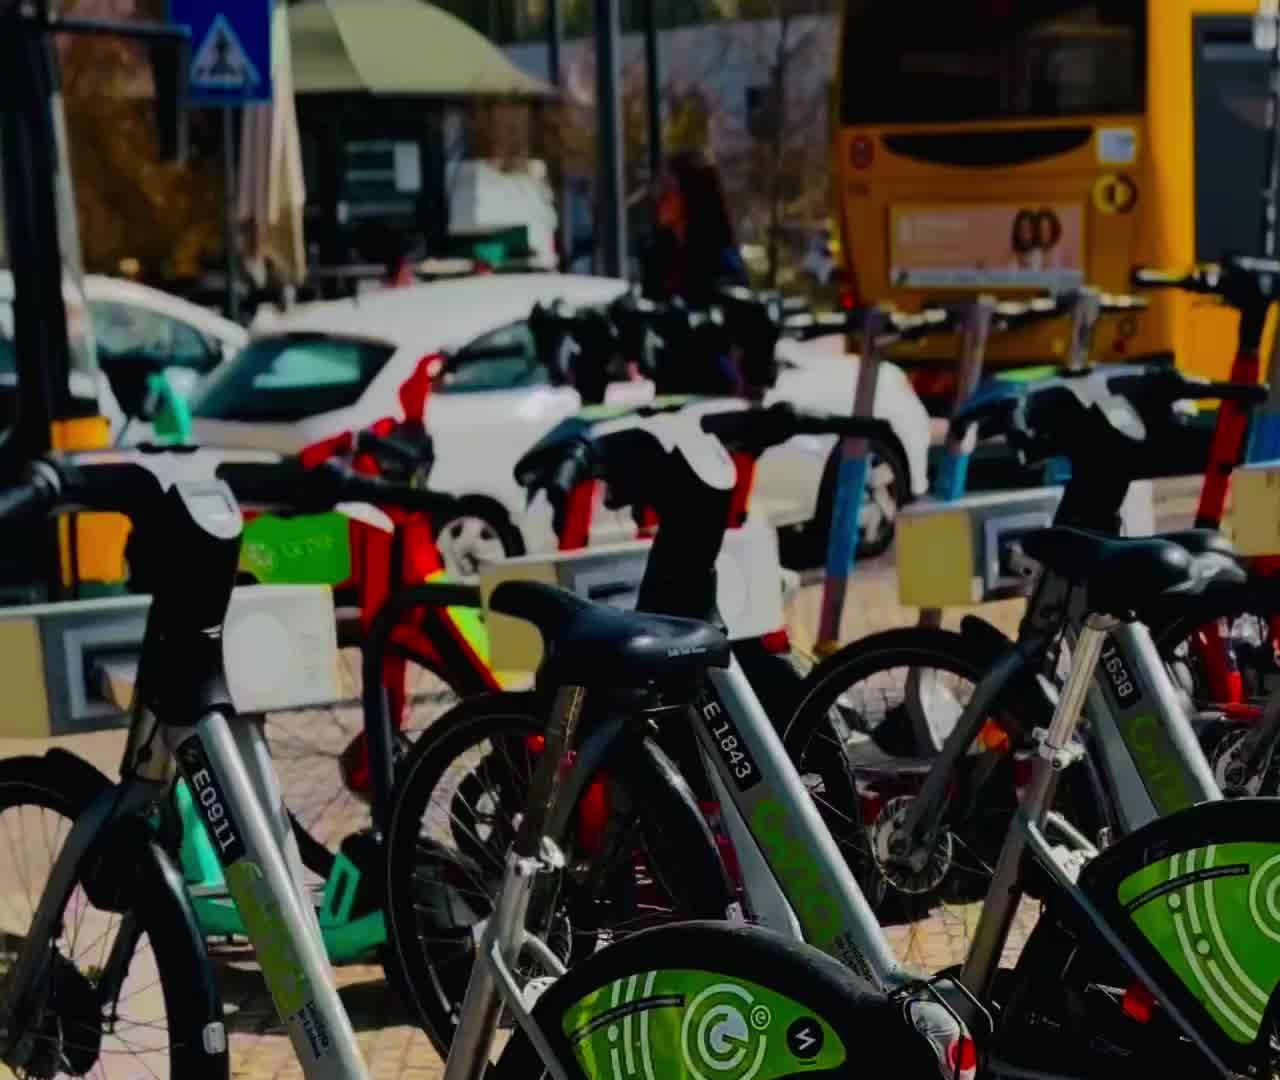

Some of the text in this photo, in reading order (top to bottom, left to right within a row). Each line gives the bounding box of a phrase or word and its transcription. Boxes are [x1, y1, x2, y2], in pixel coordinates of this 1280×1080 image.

[703, 702, 752, 779] E 1843
[191, 768, 237, 853] E0911
